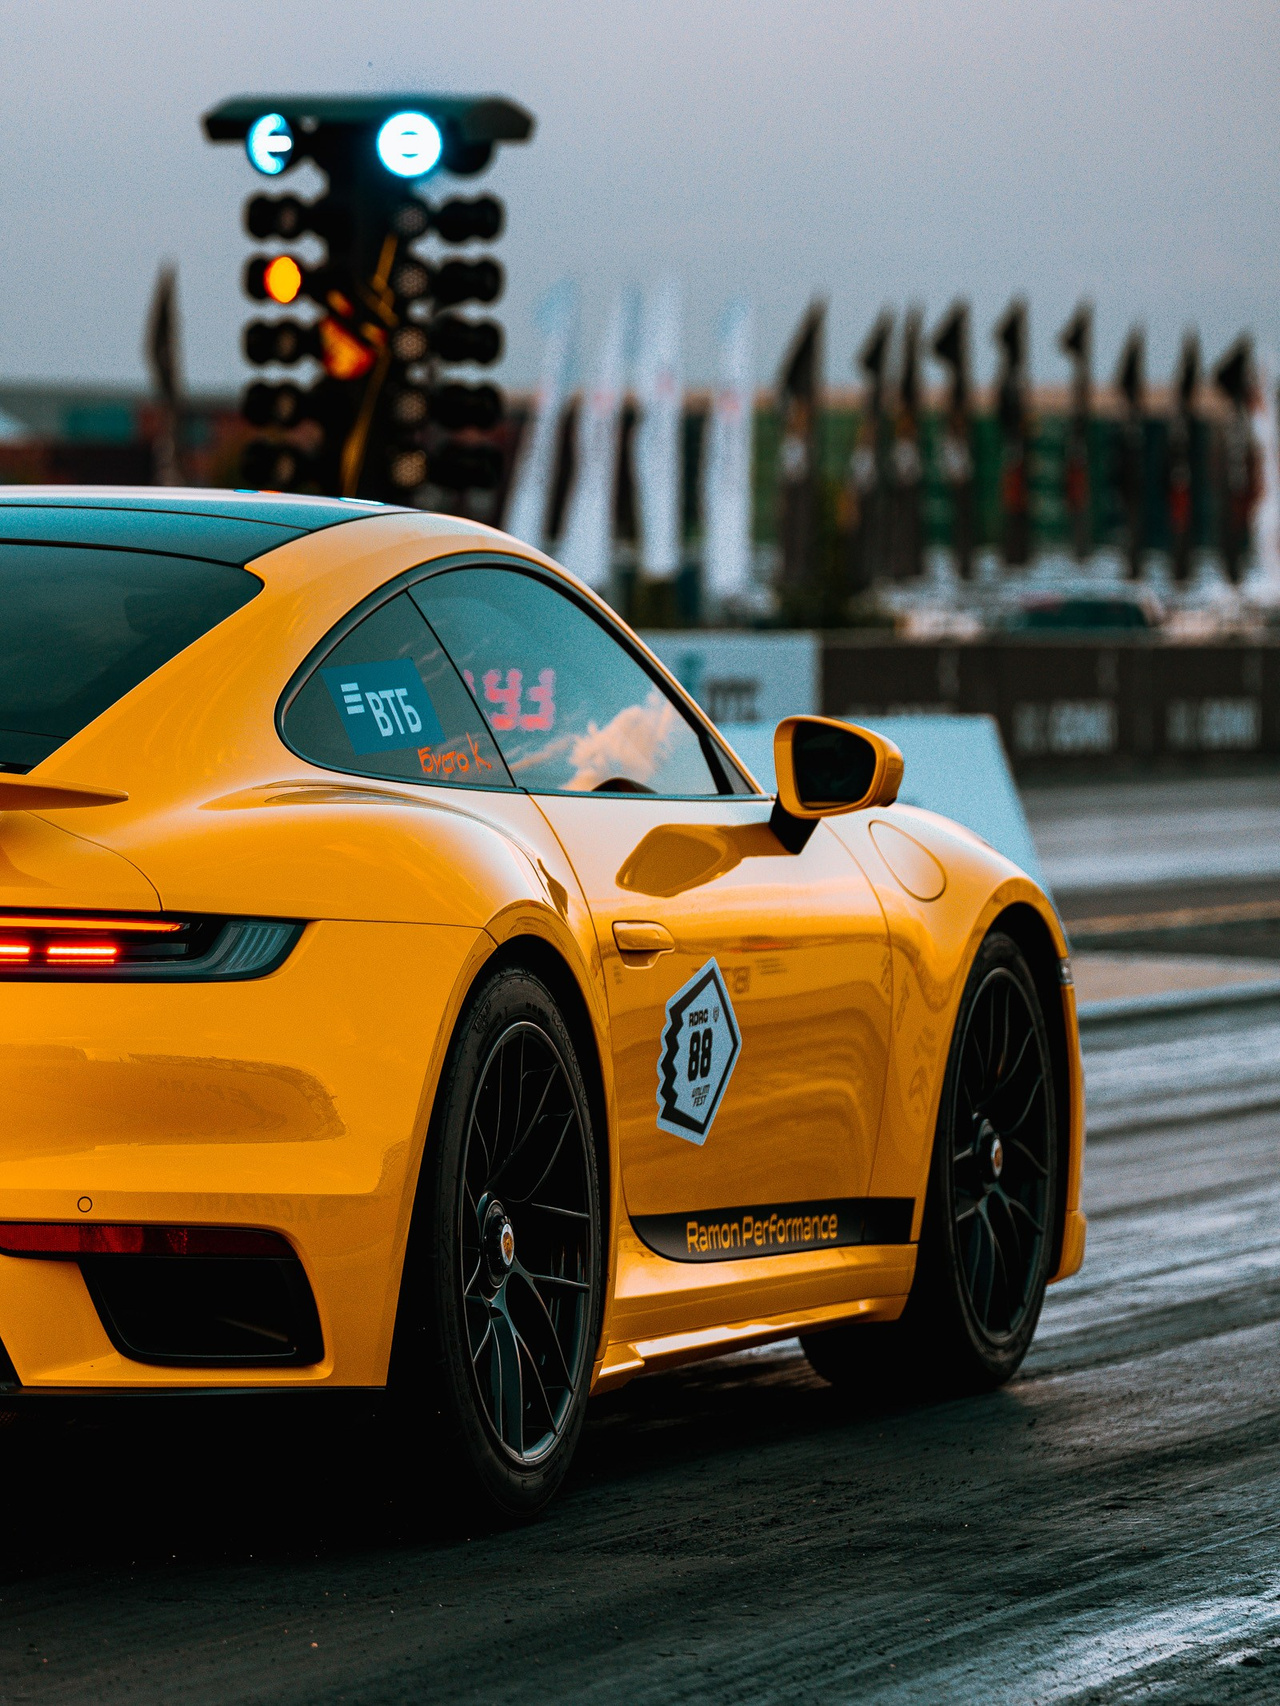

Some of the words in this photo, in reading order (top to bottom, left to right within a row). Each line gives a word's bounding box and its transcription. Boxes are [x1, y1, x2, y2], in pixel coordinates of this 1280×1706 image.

[365, 687, 422, 737] ВТБ
[688, 1028, 713, 1082] 88
[693, 1095, 708, 1107] FEST
[686, 1221, 741, 1253] Ramon
[742, 1213, 838, 1247] Performance
